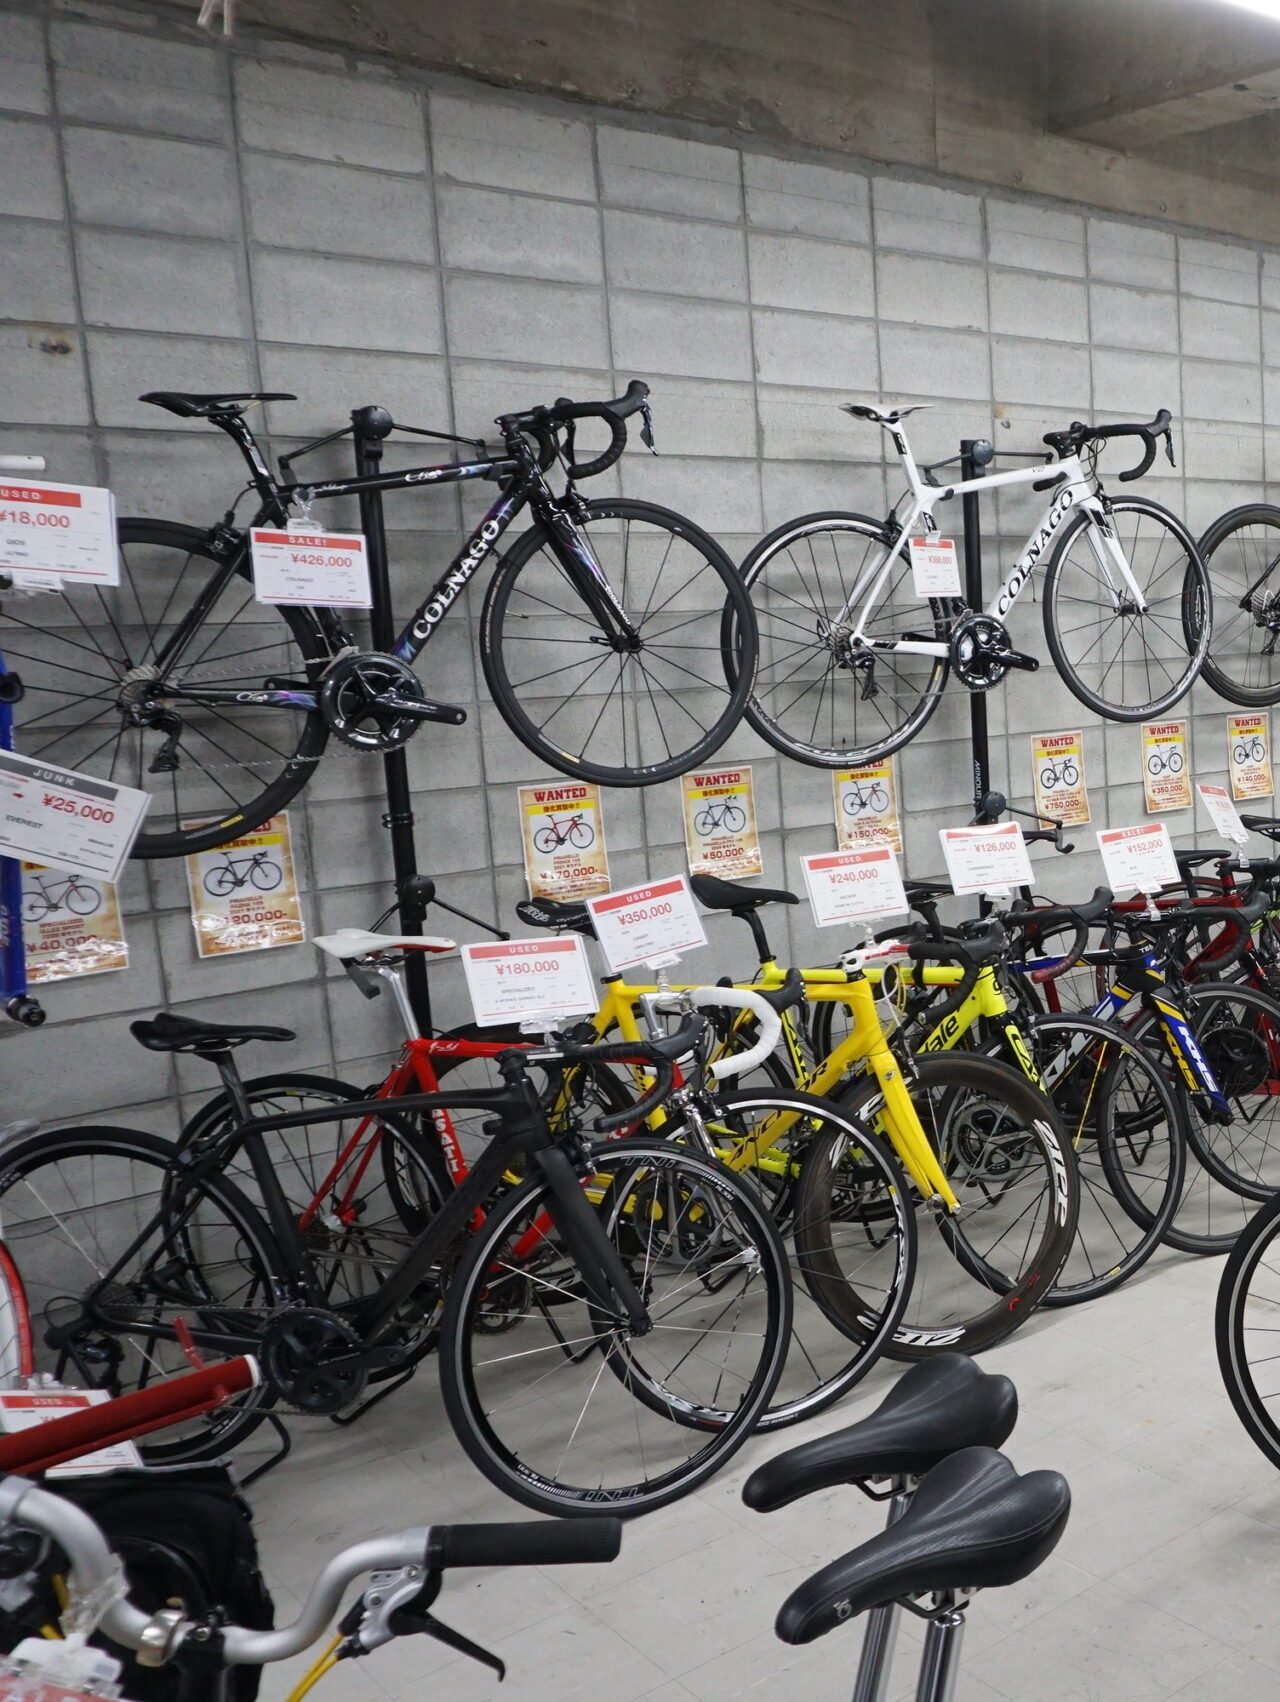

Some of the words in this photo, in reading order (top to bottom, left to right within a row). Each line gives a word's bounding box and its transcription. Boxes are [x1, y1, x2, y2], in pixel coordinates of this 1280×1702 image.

[1, 490, 41, 500] USED
[0, 509, 70, 528] ¥18,000
[288, 536, 327, 546] SALE!
[998, 489, 1074, 616] COLNAGO
[290, 552, 353, 568] ¥426,000
[412, 519, 501, 640] COLNAGO
[1235, 718, 1261, 727] WANTED
[1150, 725, 1179, 735] WANTED
[1041, 737, 1074, 748] WANTED
[33, 769, 75, 787] JUNK
[694, 773, 741, 787] WANTED
[534, 787, 587, 803] WANTED
[42, 793, 114, 824] ¥25,000
[1045, 799, 1081, 809] ¥750,000-
[974, 841, 1016, 853] ¥126,000
[1126, 839, 1163, 853] ¥152,000
[838, 855, 860, 864] USED
[829, 868, 878, 884] ¥240,000
[626, 889, 652, 902] USED
[618, 902, 672, 925] ¥350,000
[509, 945, 538, 954] USED
[495, 959, 560, 976] ¥180,000
[32, 1398, 64, 1406] USED
